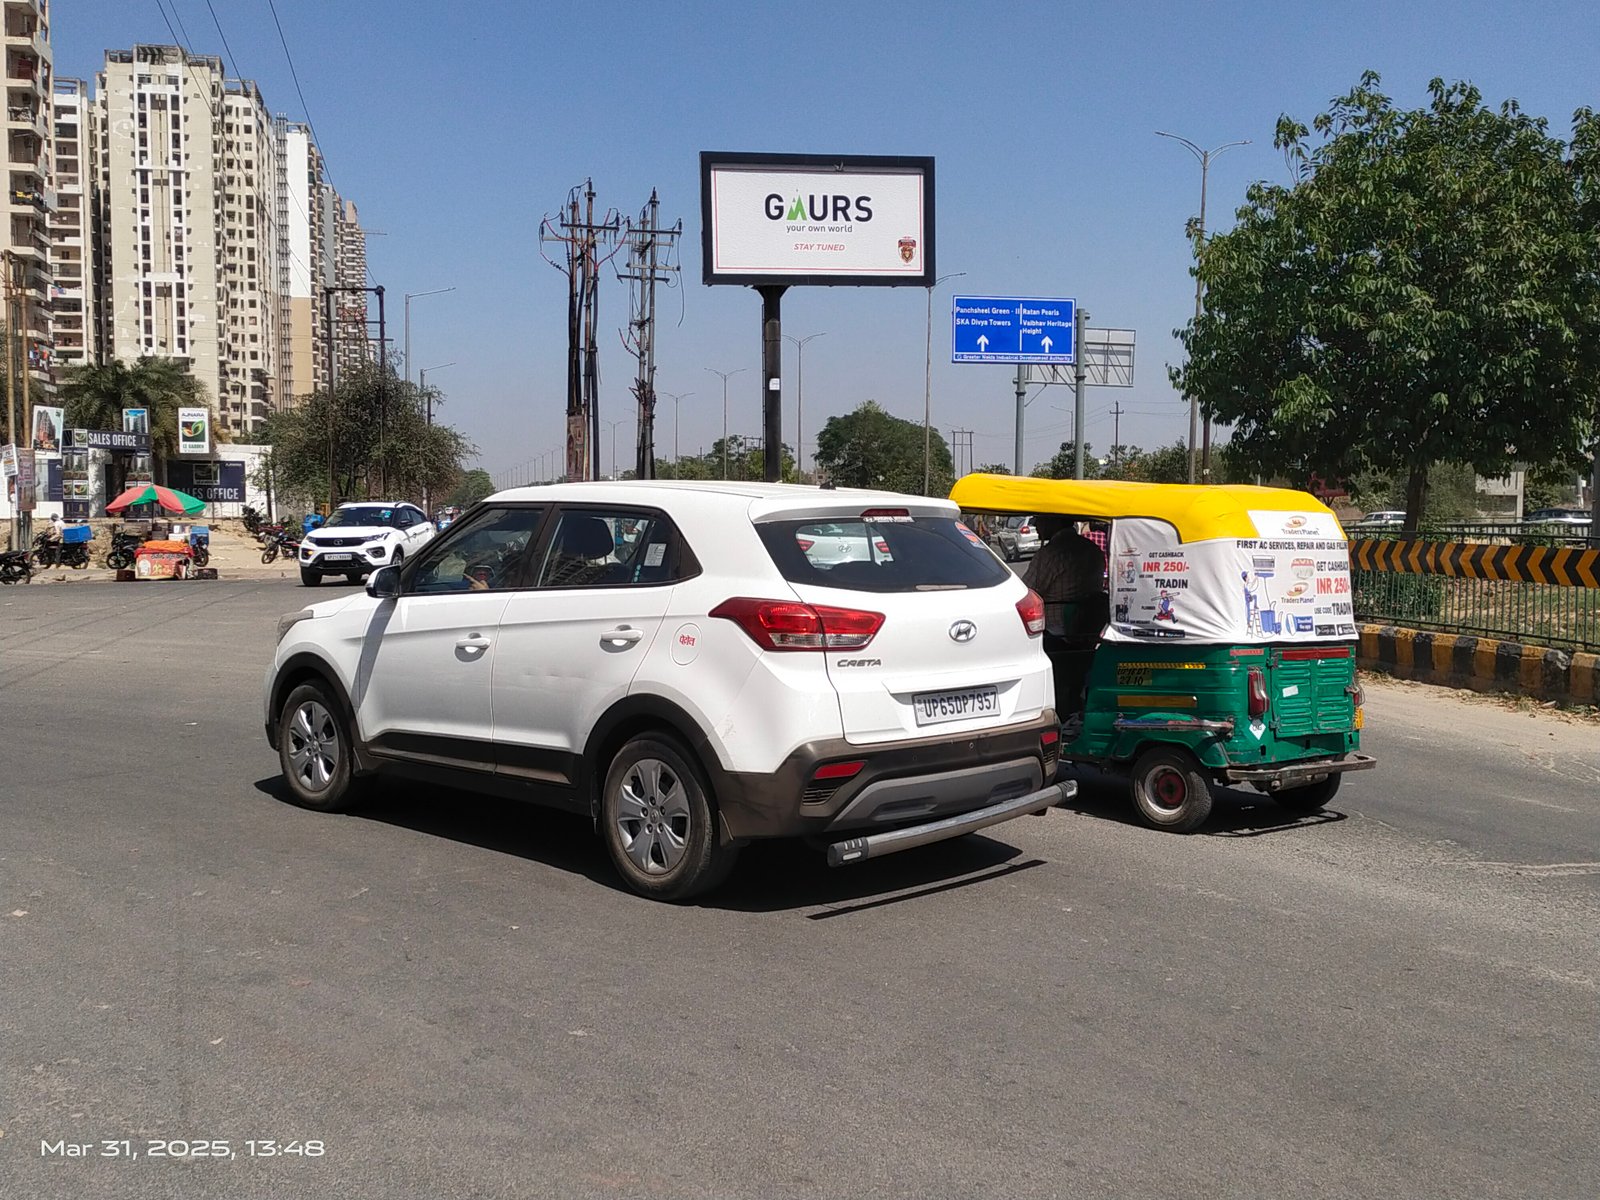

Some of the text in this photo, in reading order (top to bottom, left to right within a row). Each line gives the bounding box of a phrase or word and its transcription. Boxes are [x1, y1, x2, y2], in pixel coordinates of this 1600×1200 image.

[764, 192, 873, 222] GAURS
[786, 224, 806, 233] your
[828, 224, 853, 233] world
[793, 243, 846, 251] STAY TUNED
[991, 307, 1010, 315] Green
[1041, 308, 1060, 316] Pearls
[971, 318, 988, 327] Divya
[989, 318, 1011, 326] Towers
[1022, 319, 1072, 328] Vaibhav Heritage
[1022, 327, 1042, 335] Height
[88, 432, 137, 447] SALES OFFICE
[206, 487, 239, 500] OFFICE
[1236, 540, 1258, 550] FIRST
[1258, 541, 1267, 550] AC
[1268, 541, 1296, 551] SERVICES,
[1296, 542, 1314, 550] REPAIR
[1315, 542, 1326, 550] AND
[1326, 542, 1336, 550] GAS
[1148, 551, 1158, 559] GET
[1142, 561, 1190, 572] INR 250/-
[1316, 560, 1327, 571] GET
[1154, 578, 1188, 589] TRADIN
[1316, 577, 1333, 595] INR
[1314, 606, 1323, 615] USE
[1331, 602, 1352, 616] TRADIN
[837, 658, 882, 667] CRETA
[923, 691, 997, 718] UP65DP7957
